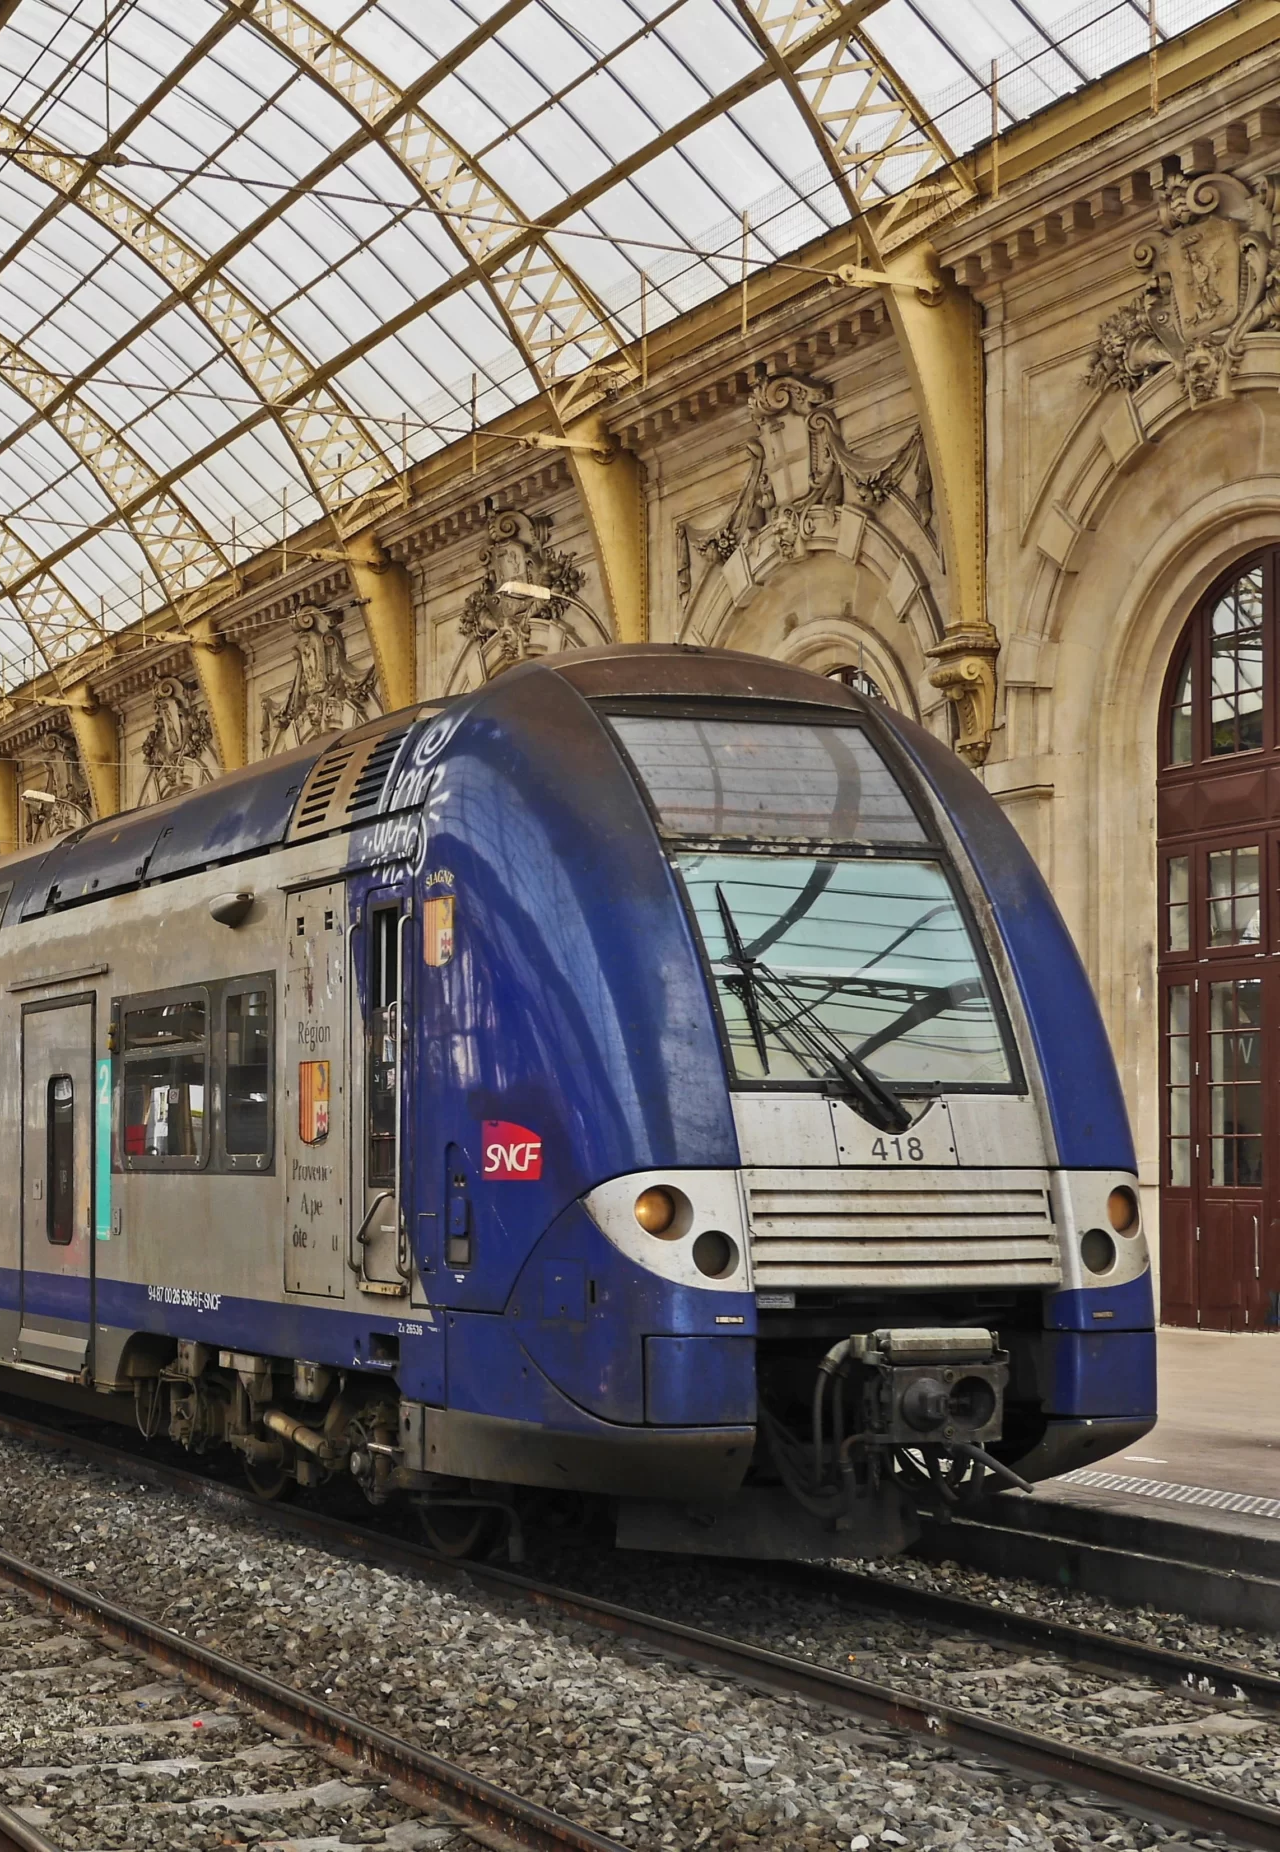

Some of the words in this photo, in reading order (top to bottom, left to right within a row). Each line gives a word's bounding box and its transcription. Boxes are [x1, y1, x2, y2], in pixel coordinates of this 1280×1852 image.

[298, 1021, 331, 1052] Région
[99, 1064, 109, 1104] 2
[484, 1142, 542, 1173] SNCF
[871, 1136, 924, 1163] 418
[292, 1158, 332, 1181] Provenc
[300, 1191, 324, 1223] Ape
[147, 1285, 156, 1301] 94
[156, 1286, 164, 1302] 87
[164, 1287, 173, 1304] 00
[172, 1288, 181, 1305] 26
[181, 1289, 197, 1307] 536-6
[406, 1323, 423, 1336] 26536
